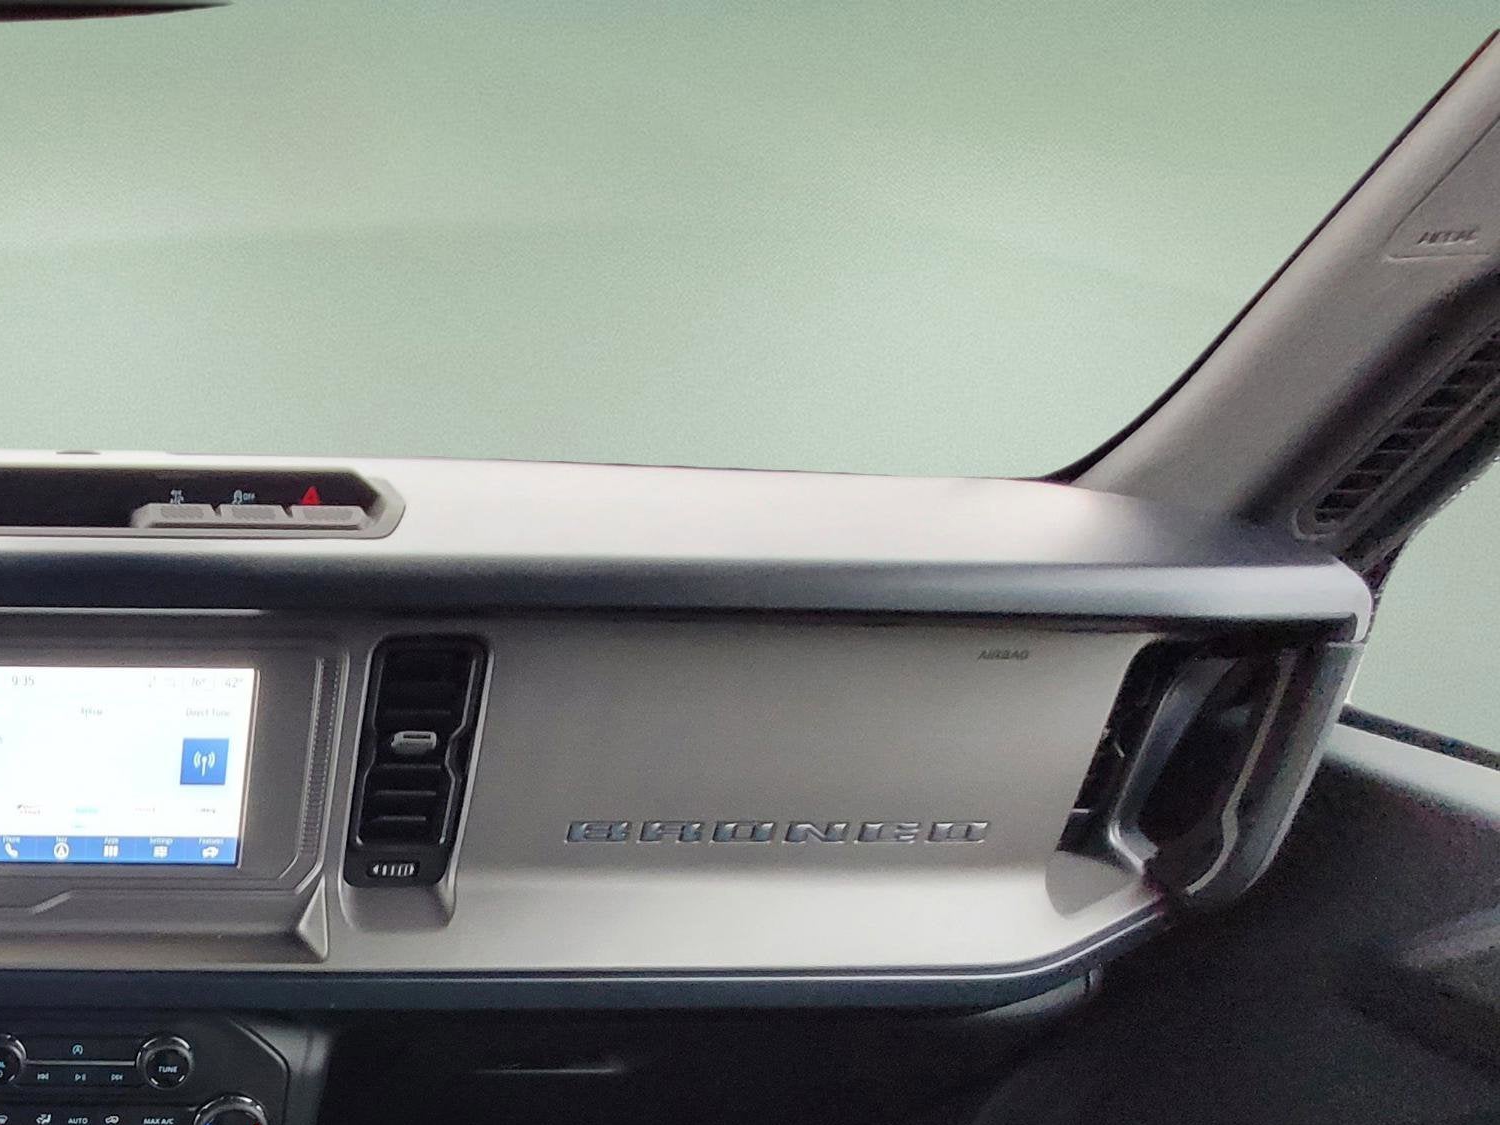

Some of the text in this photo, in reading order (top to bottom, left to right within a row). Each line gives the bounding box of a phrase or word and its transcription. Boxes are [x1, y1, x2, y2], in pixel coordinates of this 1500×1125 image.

[564, 820, 989, 844] BRONCO
[68, 1117, 88, 1125] AUTO
[143, 1117, 174, 1125] MAX A/C
